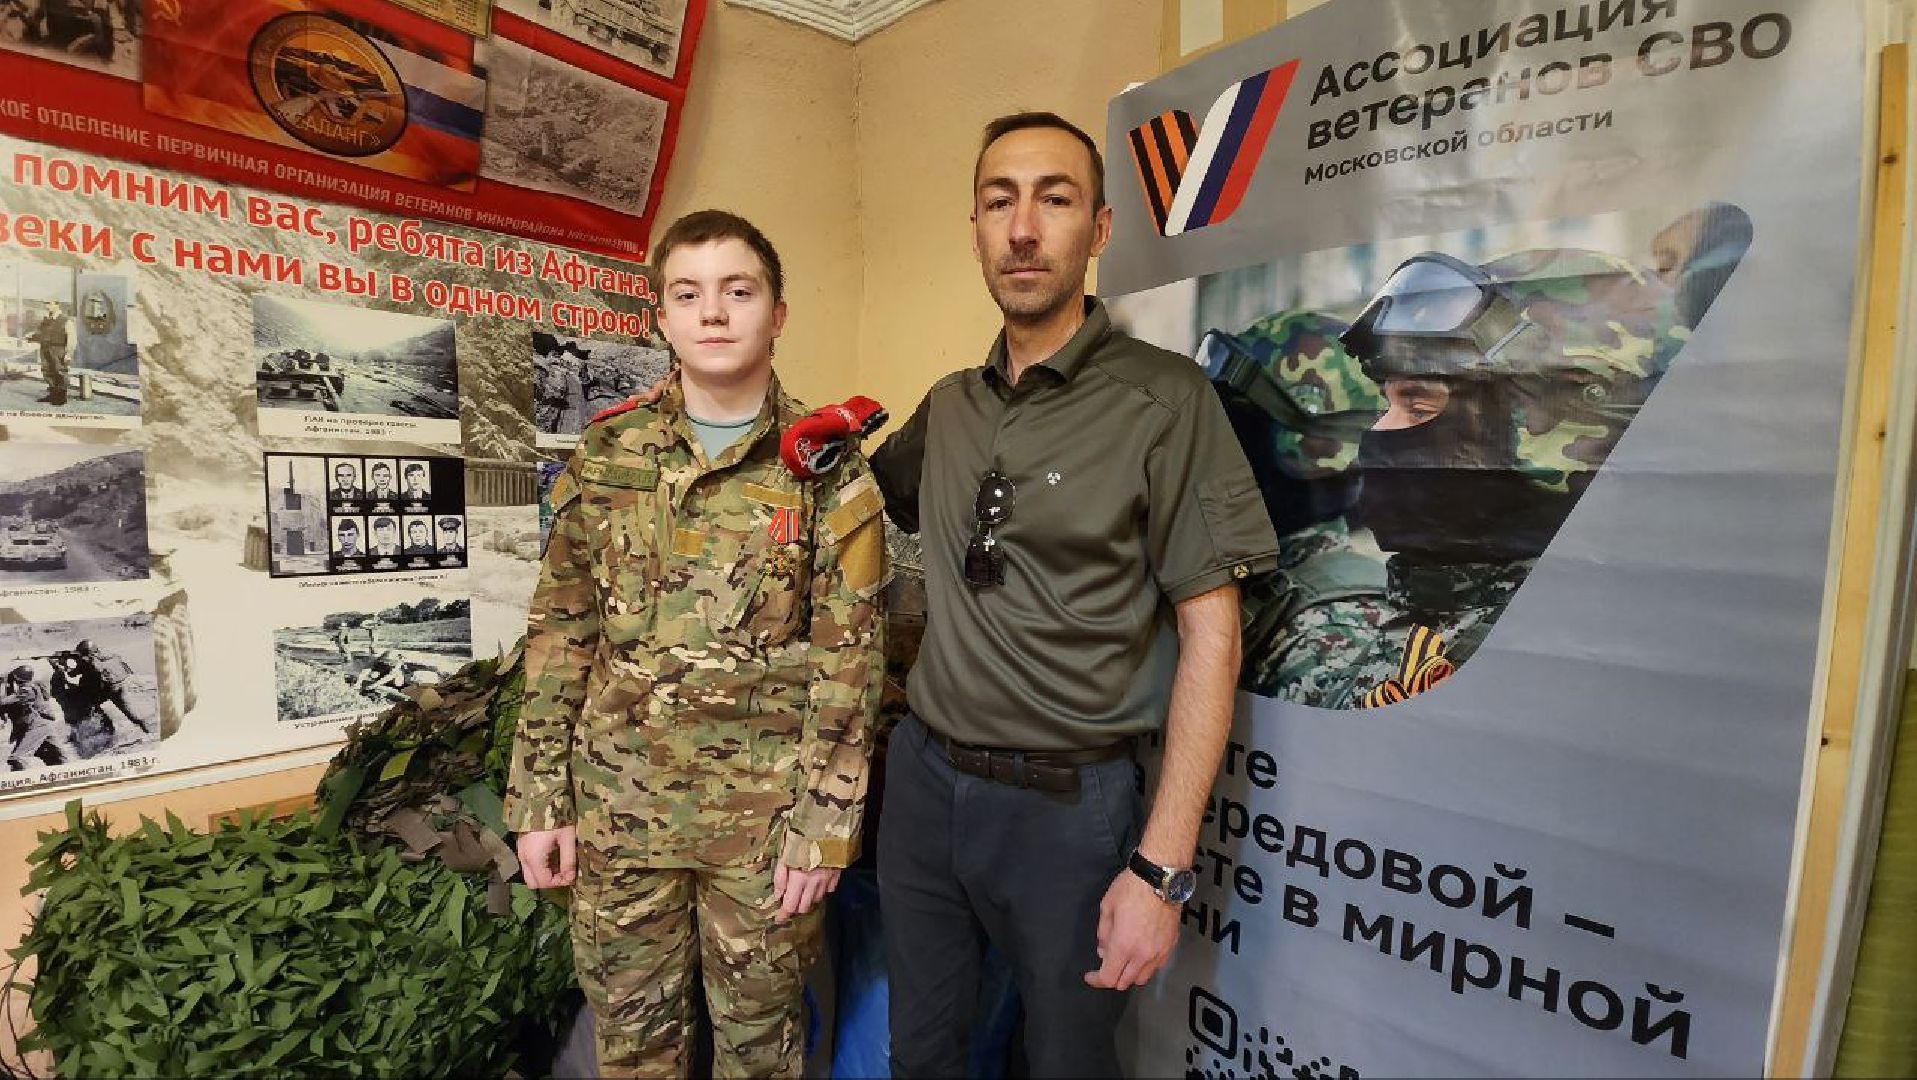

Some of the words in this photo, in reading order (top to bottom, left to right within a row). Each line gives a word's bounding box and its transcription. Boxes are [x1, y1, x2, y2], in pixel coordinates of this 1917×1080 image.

[1307, 53, 1612, 149] ветеранов
[1637, 13, 1792, 76] СВО
[1310, 0, 1677, 106] Ассоциация
[37, 107, 151, 147] ОТДЕЛЕНИЕ
[157, 135, 268, 175] ПЕРВИЧНАЯ
[275, 164, 390, 201] ОРГАНИЗАЦИЯ
[395, 193, 472, 221] ВЕТЕРАНОВ
[1304, 130, 1468, 185] Московской
[1477, 109, 1613, 147] области
[13, 153, 230, 220] помним
[248, 197, 337, 245] вас,
[348, 216, 484, 268] ребята
[495, 246, 533, 276] из
[540, 249, 656, 304] Афгана,
[132, 232, 156, 263] с
[174, 238, 302, 285] нами
[318, 262, 378, 298] вы
[390, 273, 413, 303] в
[424, 280, 542, 322] одном
[551, 301, 651, 338] строю!
[1203, 796, 1533, 929] редовой
[1283, 884, 1318, 927] в
[1342, 903, 1690, 1060] мирной
